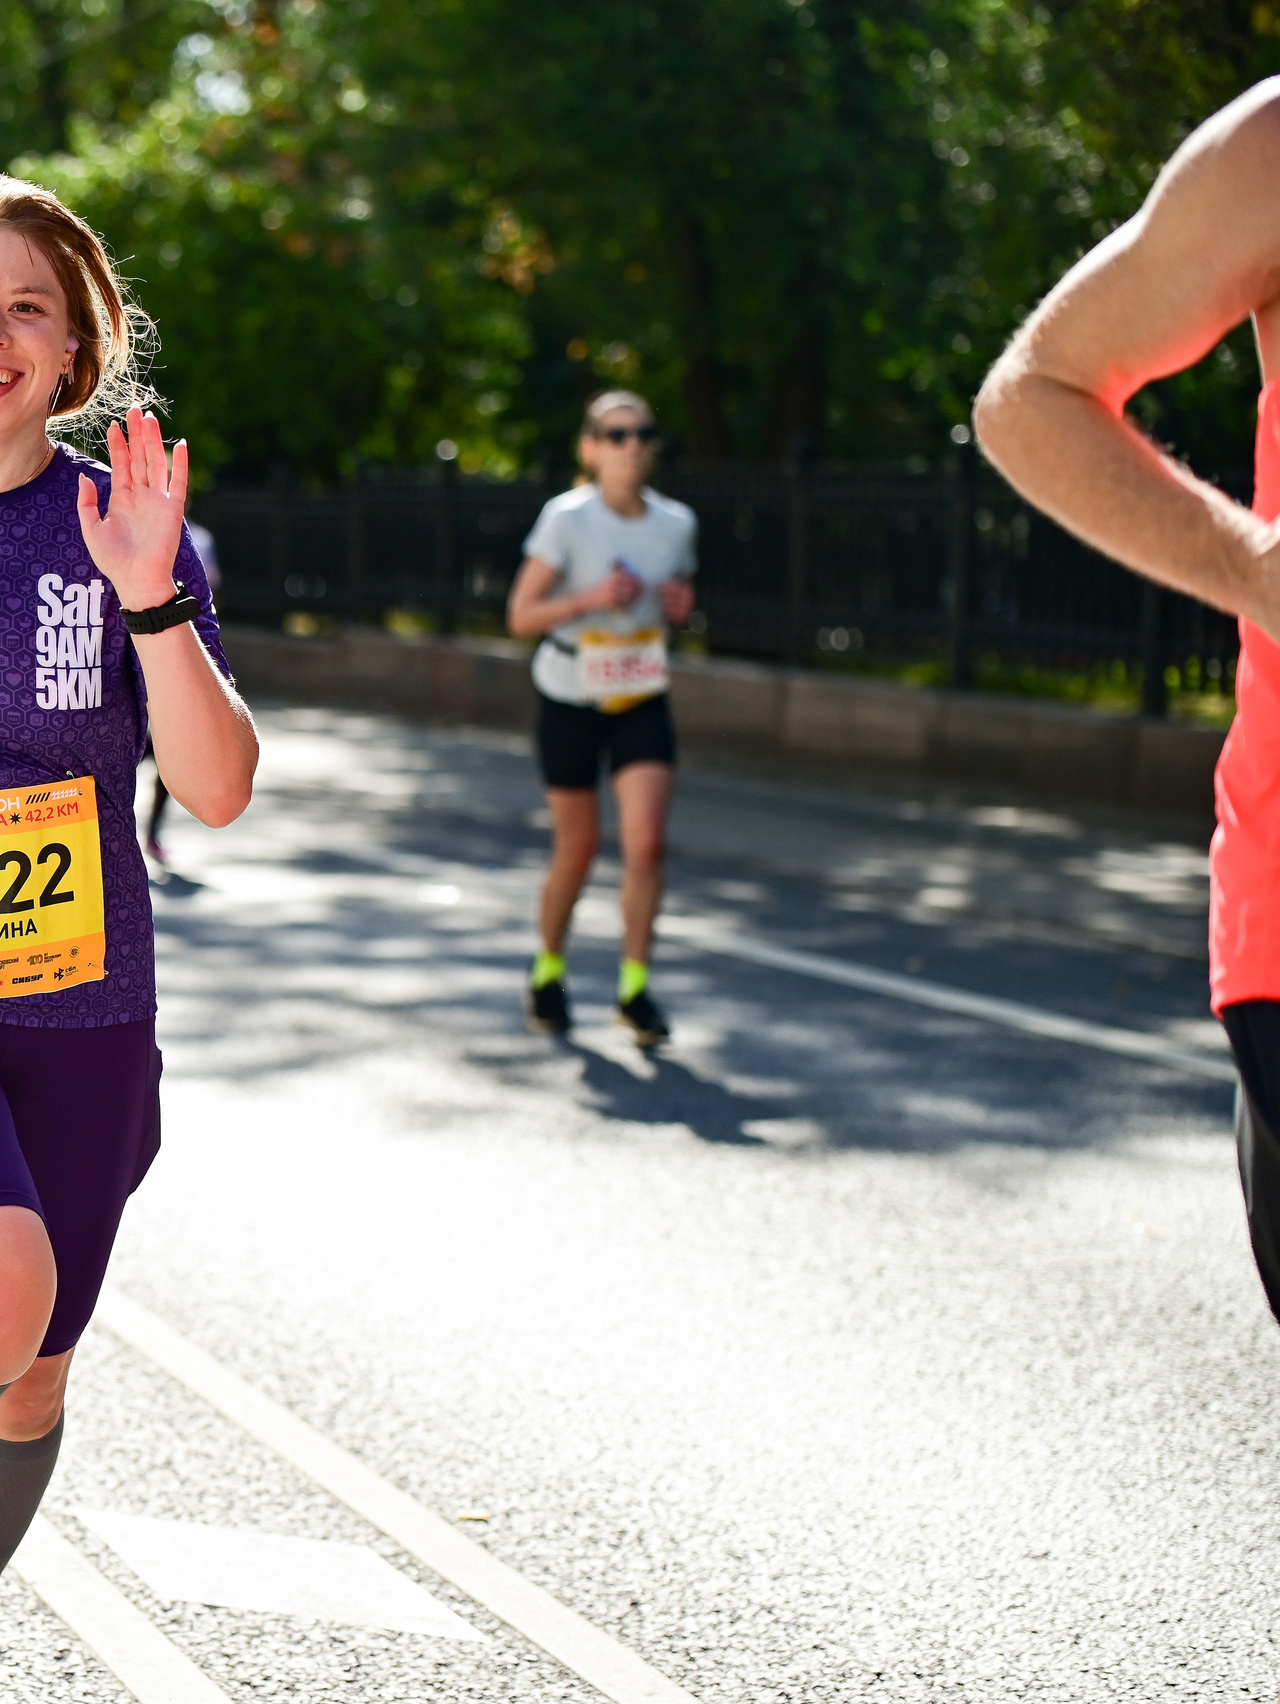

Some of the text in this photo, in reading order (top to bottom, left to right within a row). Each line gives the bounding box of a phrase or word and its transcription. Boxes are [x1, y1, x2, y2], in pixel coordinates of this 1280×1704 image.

[37, 573, 104, 627] Sat
[36, 626, 102, 668] 9AM
[35, 667, 101, 710] 5KM
[25, 807, 55, 823] 42,2
[57, 802, 79, 816] КМ
[12, 974, 44, 985] СИБУР
